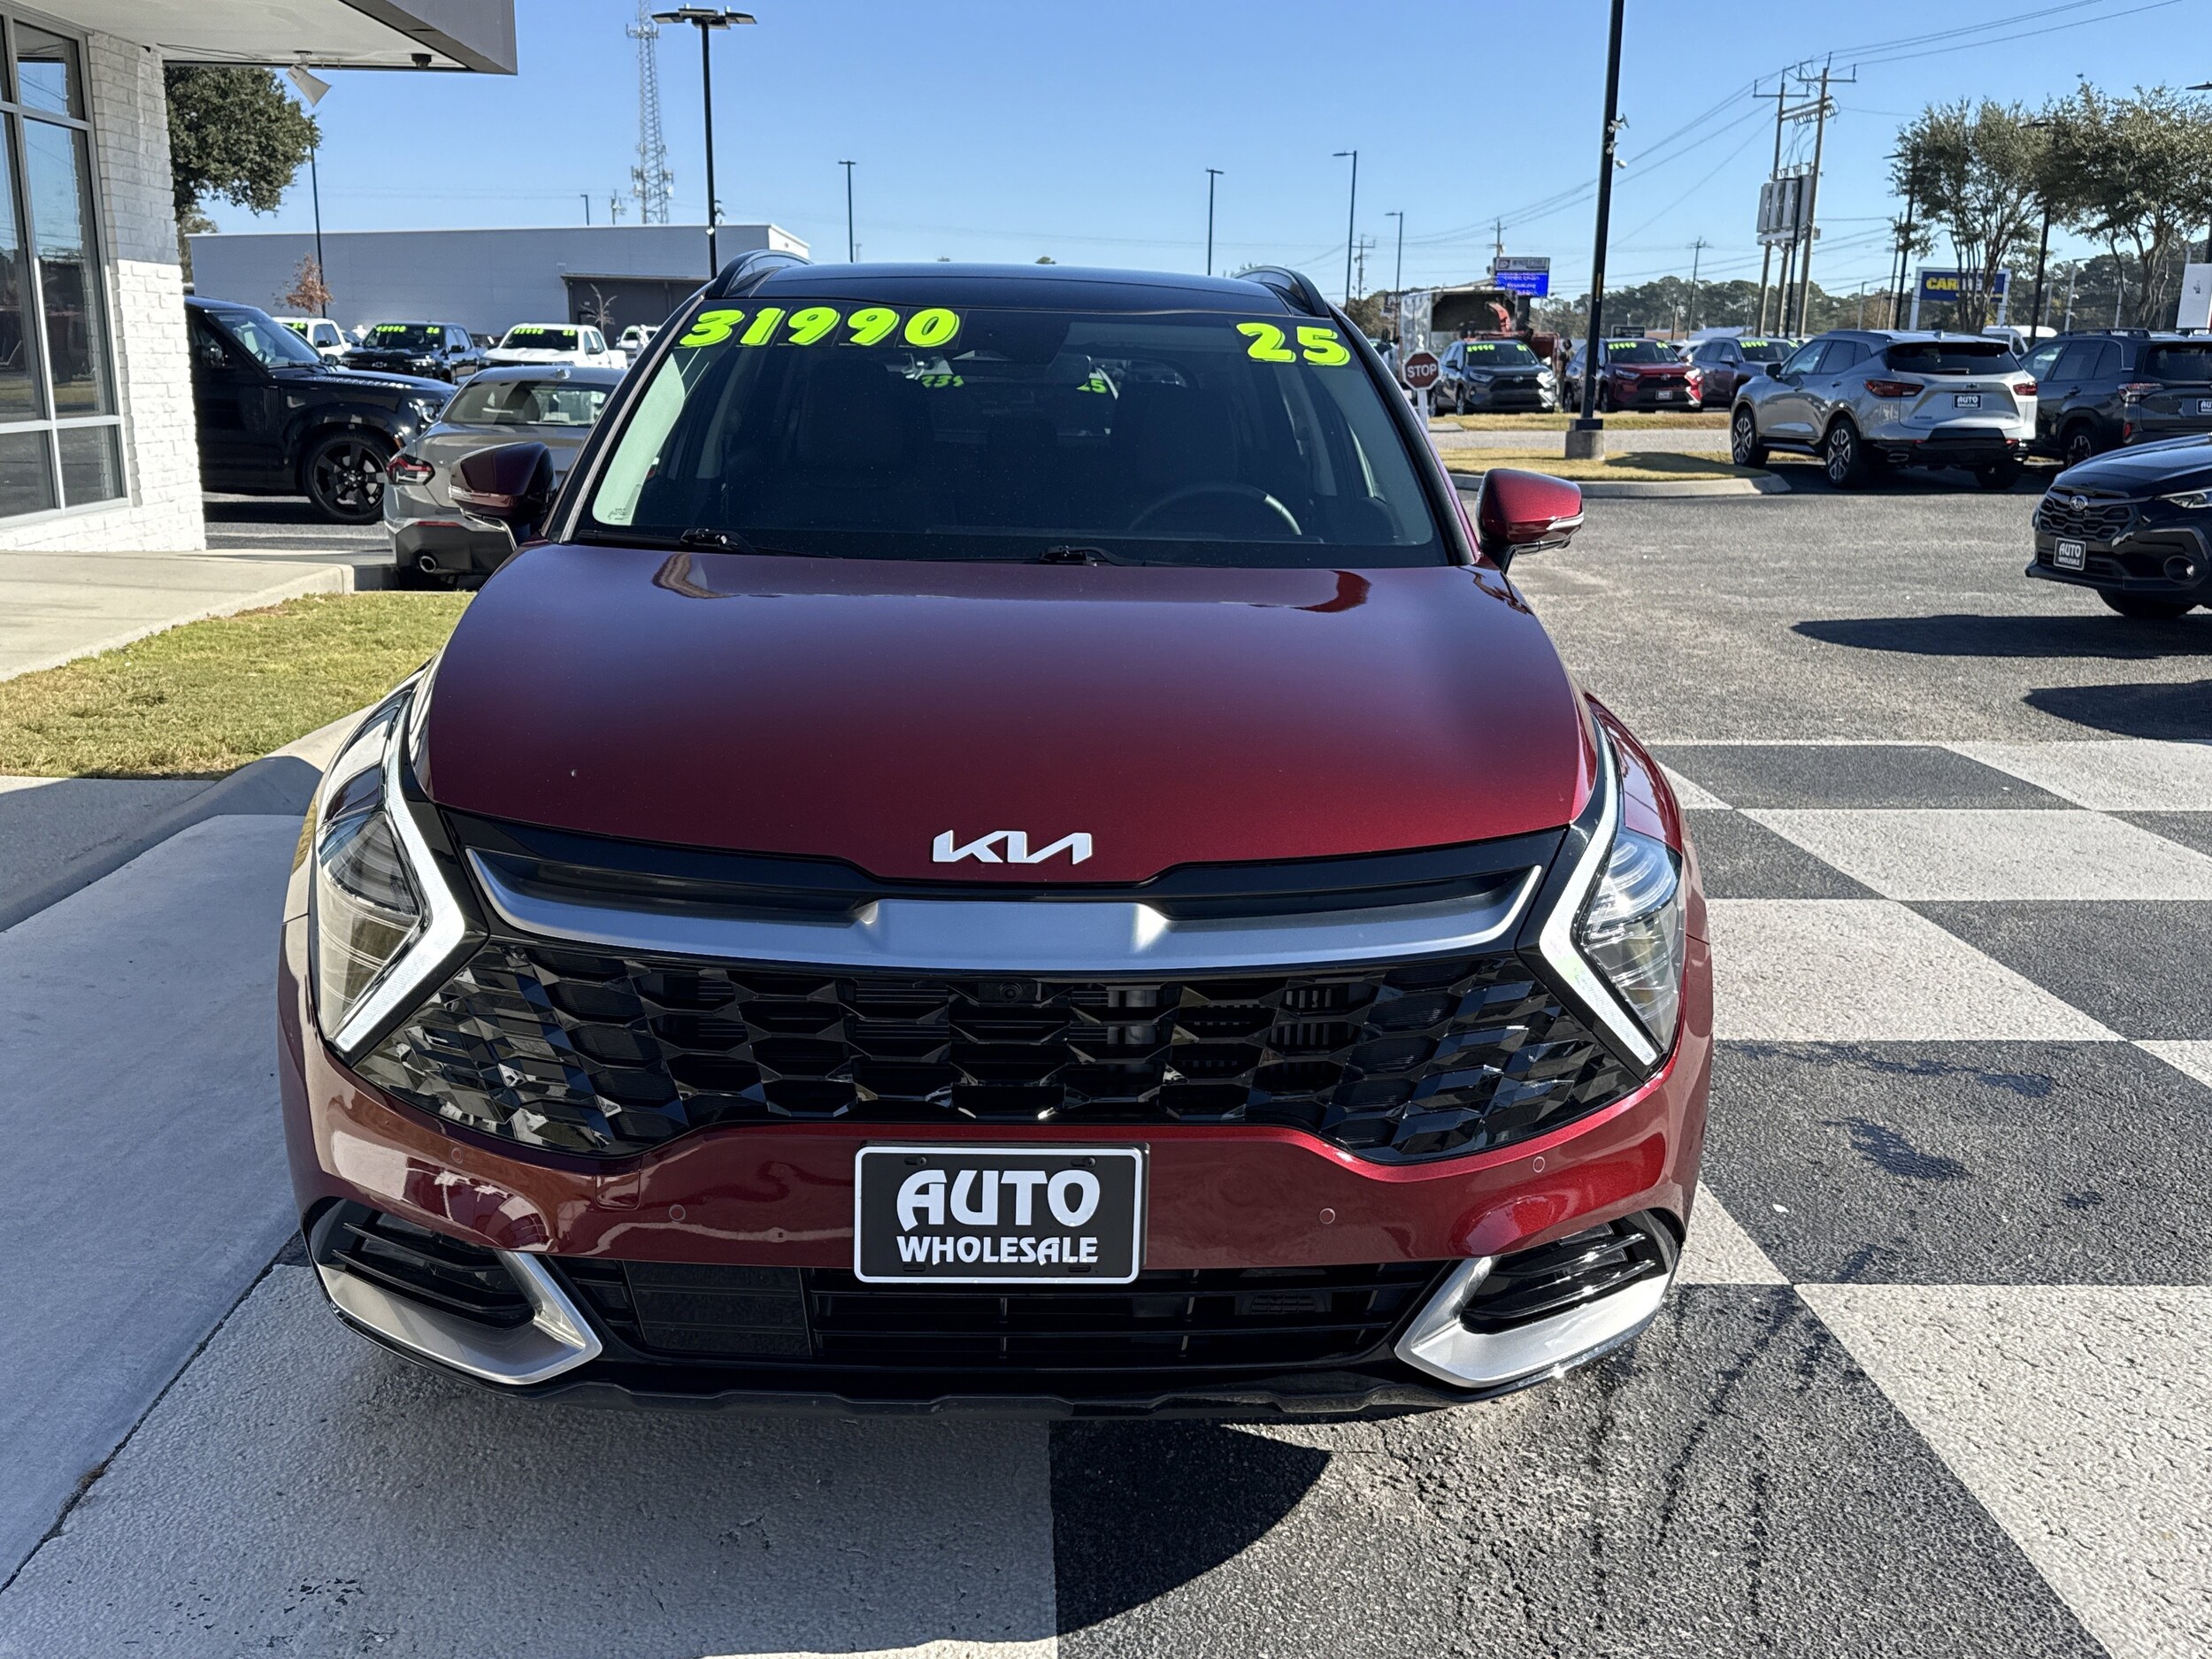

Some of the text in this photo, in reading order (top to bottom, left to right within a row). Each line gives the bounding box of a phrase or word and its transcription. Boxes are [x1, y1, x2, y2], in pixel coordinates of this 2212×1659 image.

[679, 306, 961, 348] 31990
[1235, 322, 1351, 366] 25
[1407, 363, 1437, 378] STOP
[1956, 396, 1979, 404] AUTO
[2058, 542, 2082, 558] AUTO
[896, 1169, 1101, 1233] AUTO
[896, 1235, 1099, 1266] WHOLESALE
